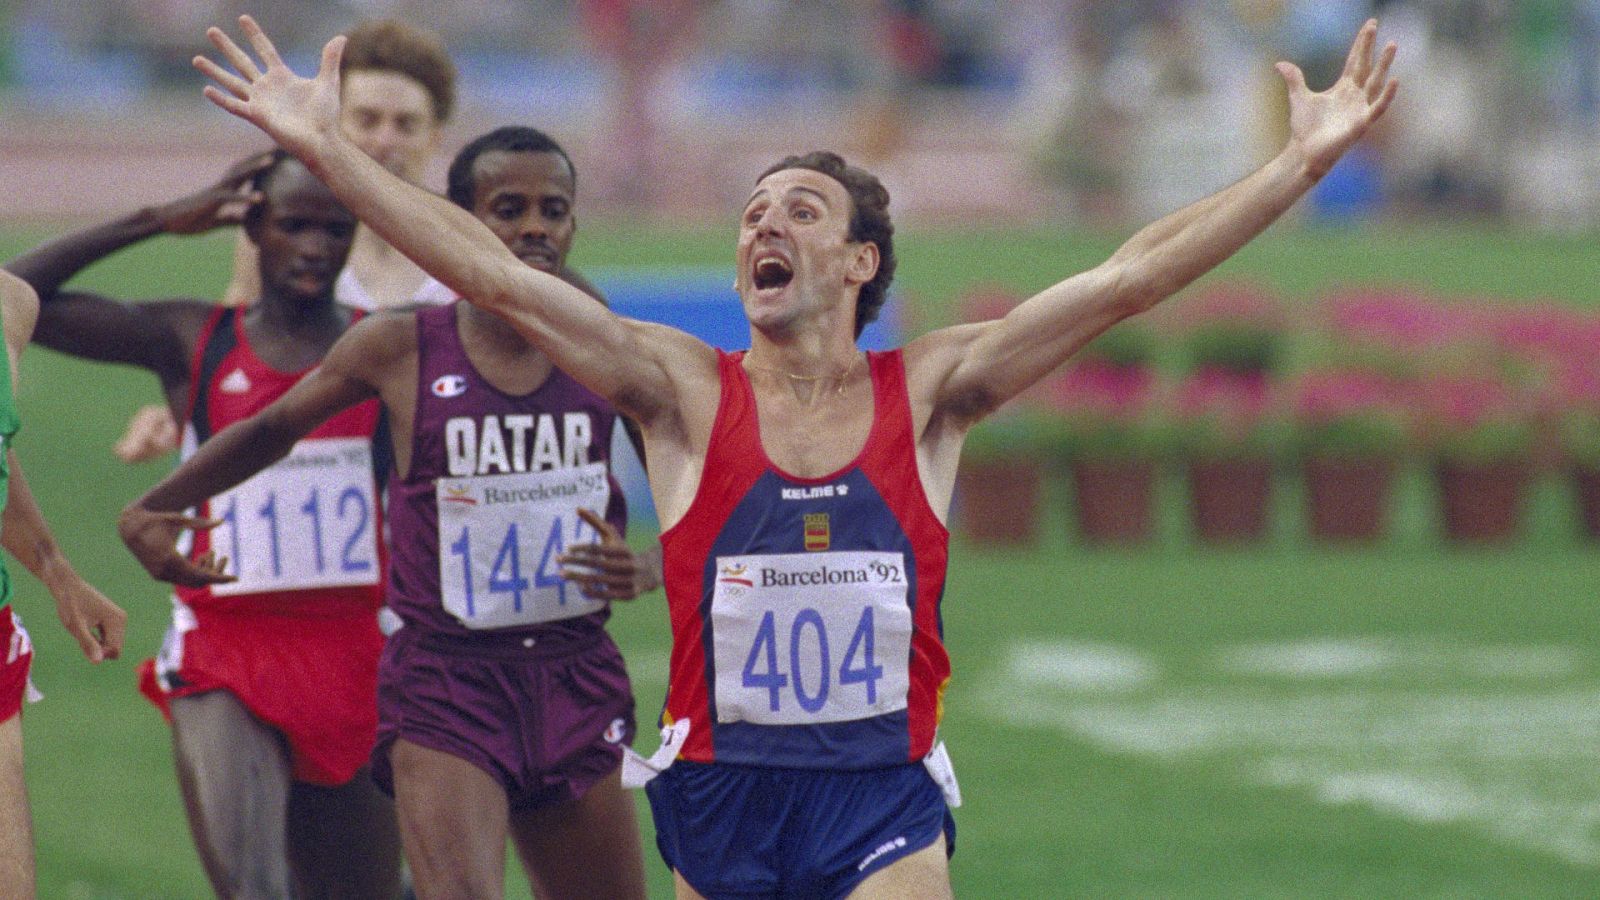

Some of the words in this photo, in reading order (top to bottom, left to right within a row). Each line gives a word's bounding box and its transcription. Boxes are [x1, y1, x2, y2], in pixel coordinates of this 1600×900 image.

[445, 413, 592, 476] QATAR
[484, 484, 577, 504] Barcelona
[782, 485, 834, 500] KELME
[223, 487, 371, 578] 1112
[761, 566, 868, 587] Barcelona
[742, 606, 883, 713] 404
